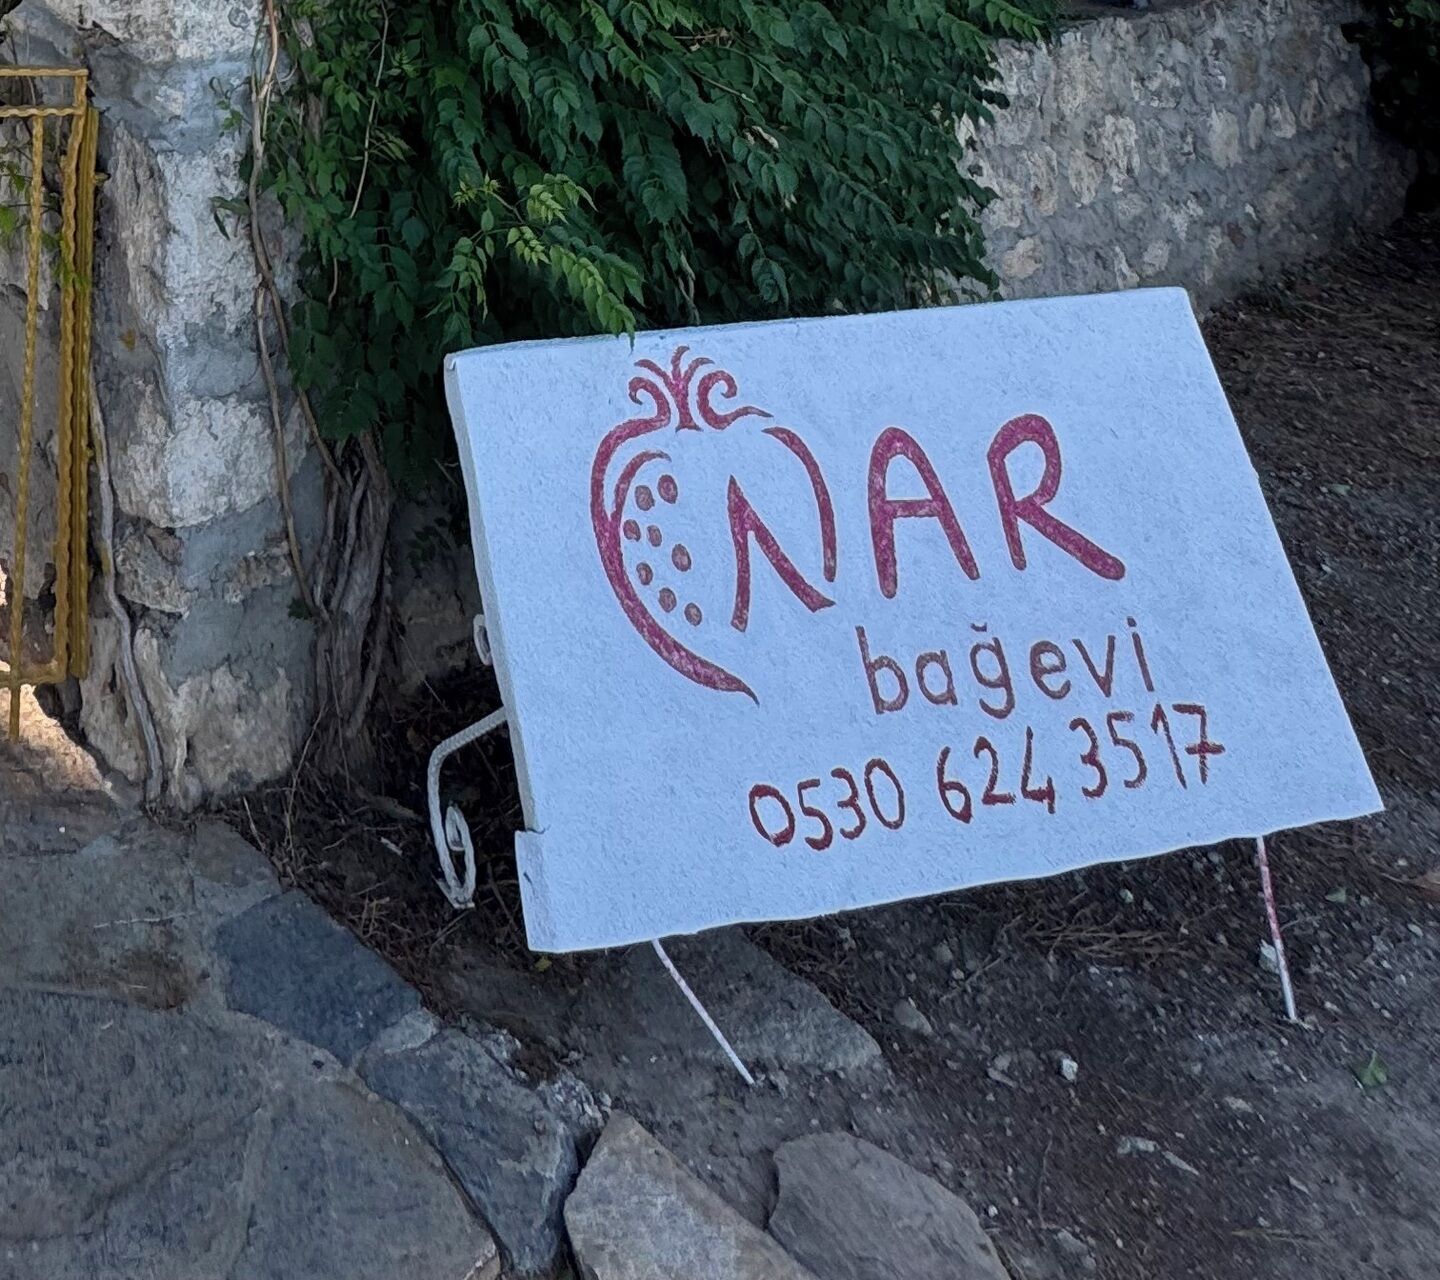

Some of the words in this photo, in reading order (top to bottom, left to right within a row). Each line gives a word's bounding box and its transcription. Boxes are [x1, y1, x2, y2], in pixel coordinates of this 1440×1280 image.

[729, 414, 1126, 633] NAR
[854, 618, 1157, 719] bağevi
[748, 757, 906, 851] 0530
